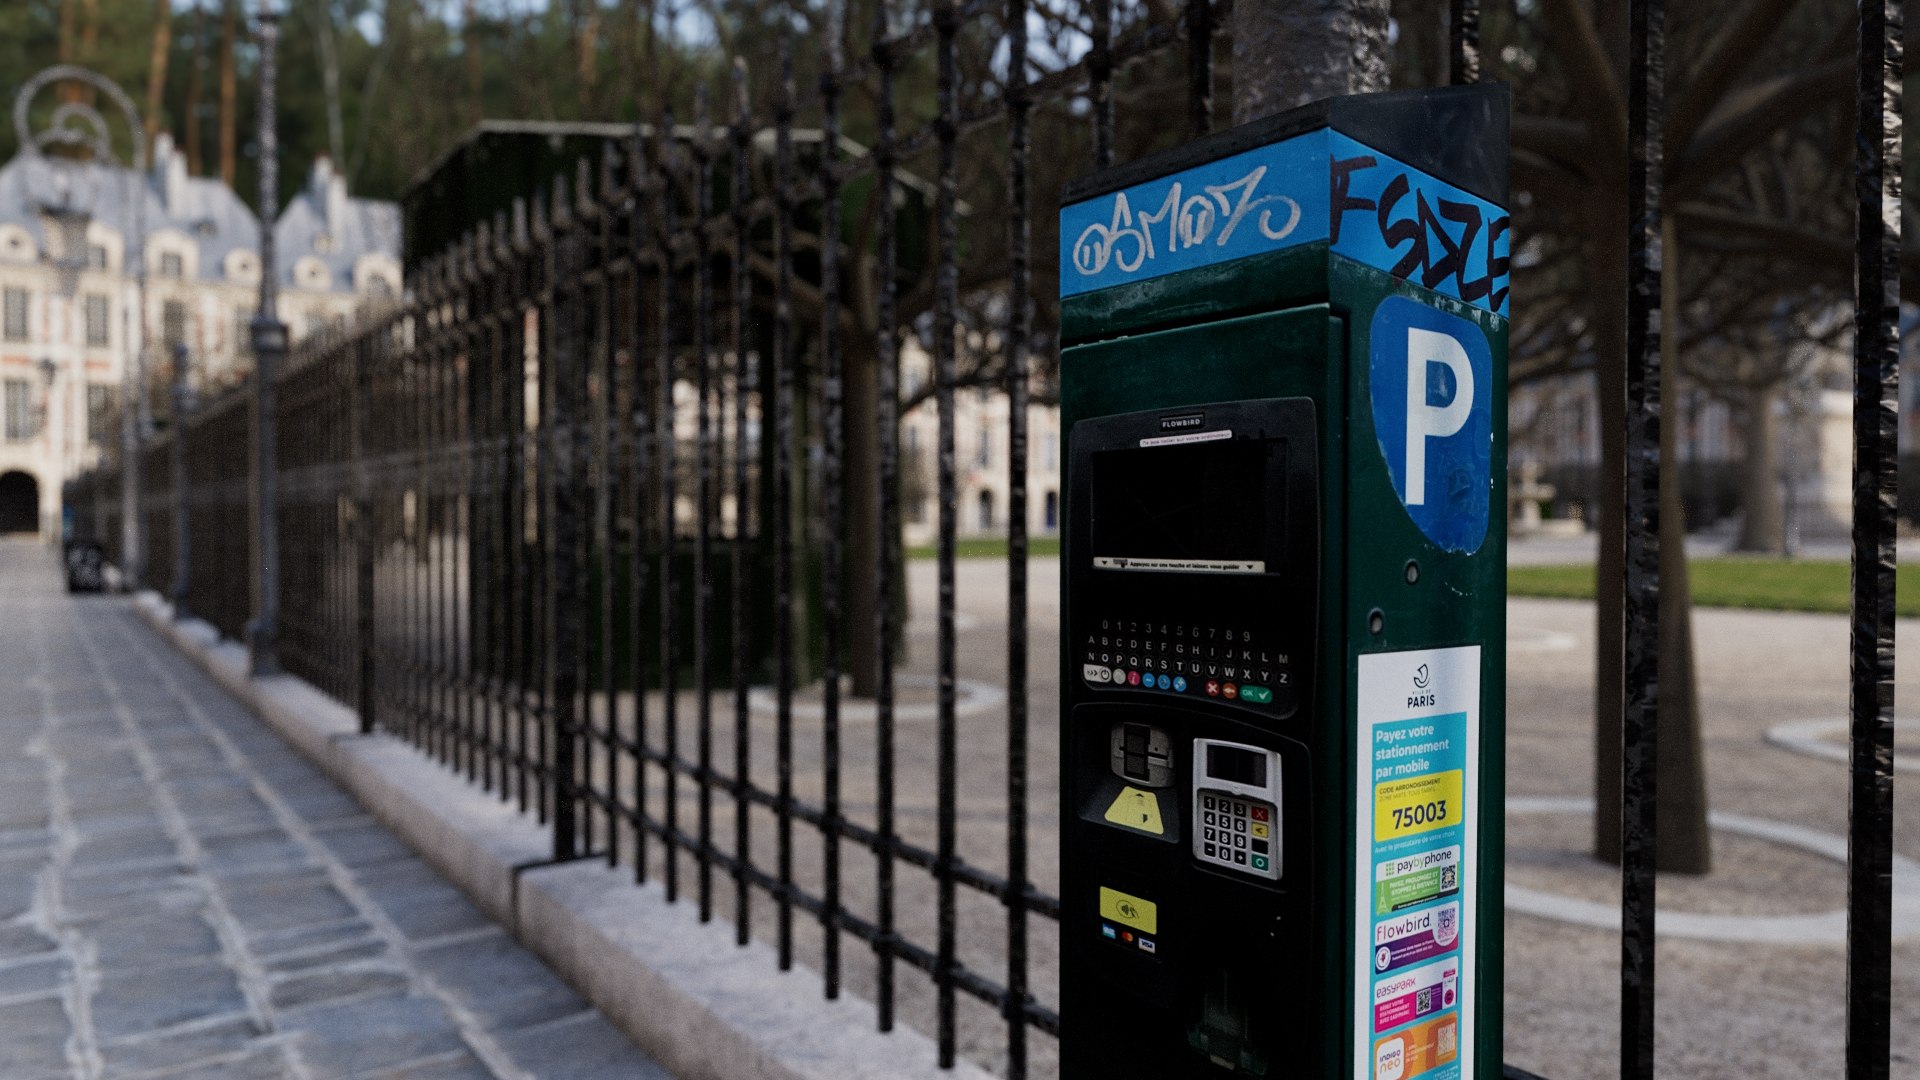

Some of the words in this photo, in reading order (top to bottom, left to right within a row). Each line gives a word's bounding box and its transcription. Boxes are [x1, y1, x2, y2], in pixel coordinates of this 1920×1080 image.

[1162, 418, 1201, 428] FLOWBIRD
[1405, 326, 1475, 506] P
[1131, 622, 1136, 632] 2
[1146, 624, 1151, 633] 3
[1161, 625, 1167, 634] 4
[1177, 626, 1183, 636] 5
[1192, 627, 1199, 637] 6
[1209, 629, 1215, 638] 7
[1226, 630, 1232, 640] 8
[1243, 632, 1250, 641] 9
[1102, 637, 1108, 645] B
[1116, 639, 1122, 647] C
[1131, 640, 1137, 648] D
[1146, 641, 1151, 649] E
[1161, 643, 1166, 651] F
[1176, 644, 1183, 653] G
[1193, 646, 1199, 654] H
[1226, 650, 1232, 658] J
[1243, 651, 1250, 660] K
[1262, 653, 1268, 662] L
[1279, 654, 1287, 663] M
[1117, 655, 1122, 663] P
[1130, 657, 1137, 666] Q
[1146, 659, 1152, 667] R
[1161, 660, 1167, 669] S
[1177, 662, 1182, 670] T
[1193, 664, 1199, 673] U
[1209, 666, 1216, 674] V
[1225, 668, 1234, 676] W
[1244, 670, 1250, 679] X
[1262, 672, 1268, 680] Y
[1280, 674, 1287, 683] Z
[1242, 689, 1254, 697] OK
[1407, 694, 1435, 708] PARIS
[1376, 729, 1406, 744] Payez
[1408, 725, 1434, 738] votre
[1375, 738, 1449, 761] stationnement
[1375, 766, 1393, 782] par
[1395, 758, 1430, 775] mobile
[1379, 787, 1394, 795] CODE
[1395, 777, 1441, 791] ARRONDISSEMENT
[1206, 799, 1212, 808] 1
[1222, 802, 1228, 811] 2
[1237, 805, 1243, 815] 3
[1392, 799, 1447, 830] 75003
[1206, 814, 1213, 824] 4
[1222, 817, 1228, 827] 5
[1237, 821, 1244, 831] 6
[1206, 829, 1213, 839] 7
[1221, 833, 1228, 843] 8
[1237, 837, 1244, 847] 9
[1222, 849, 1228, 859] 0
[1397, 850, 1452, 874] paybyphone
[1380, 1058, 1401, 1074] neo
